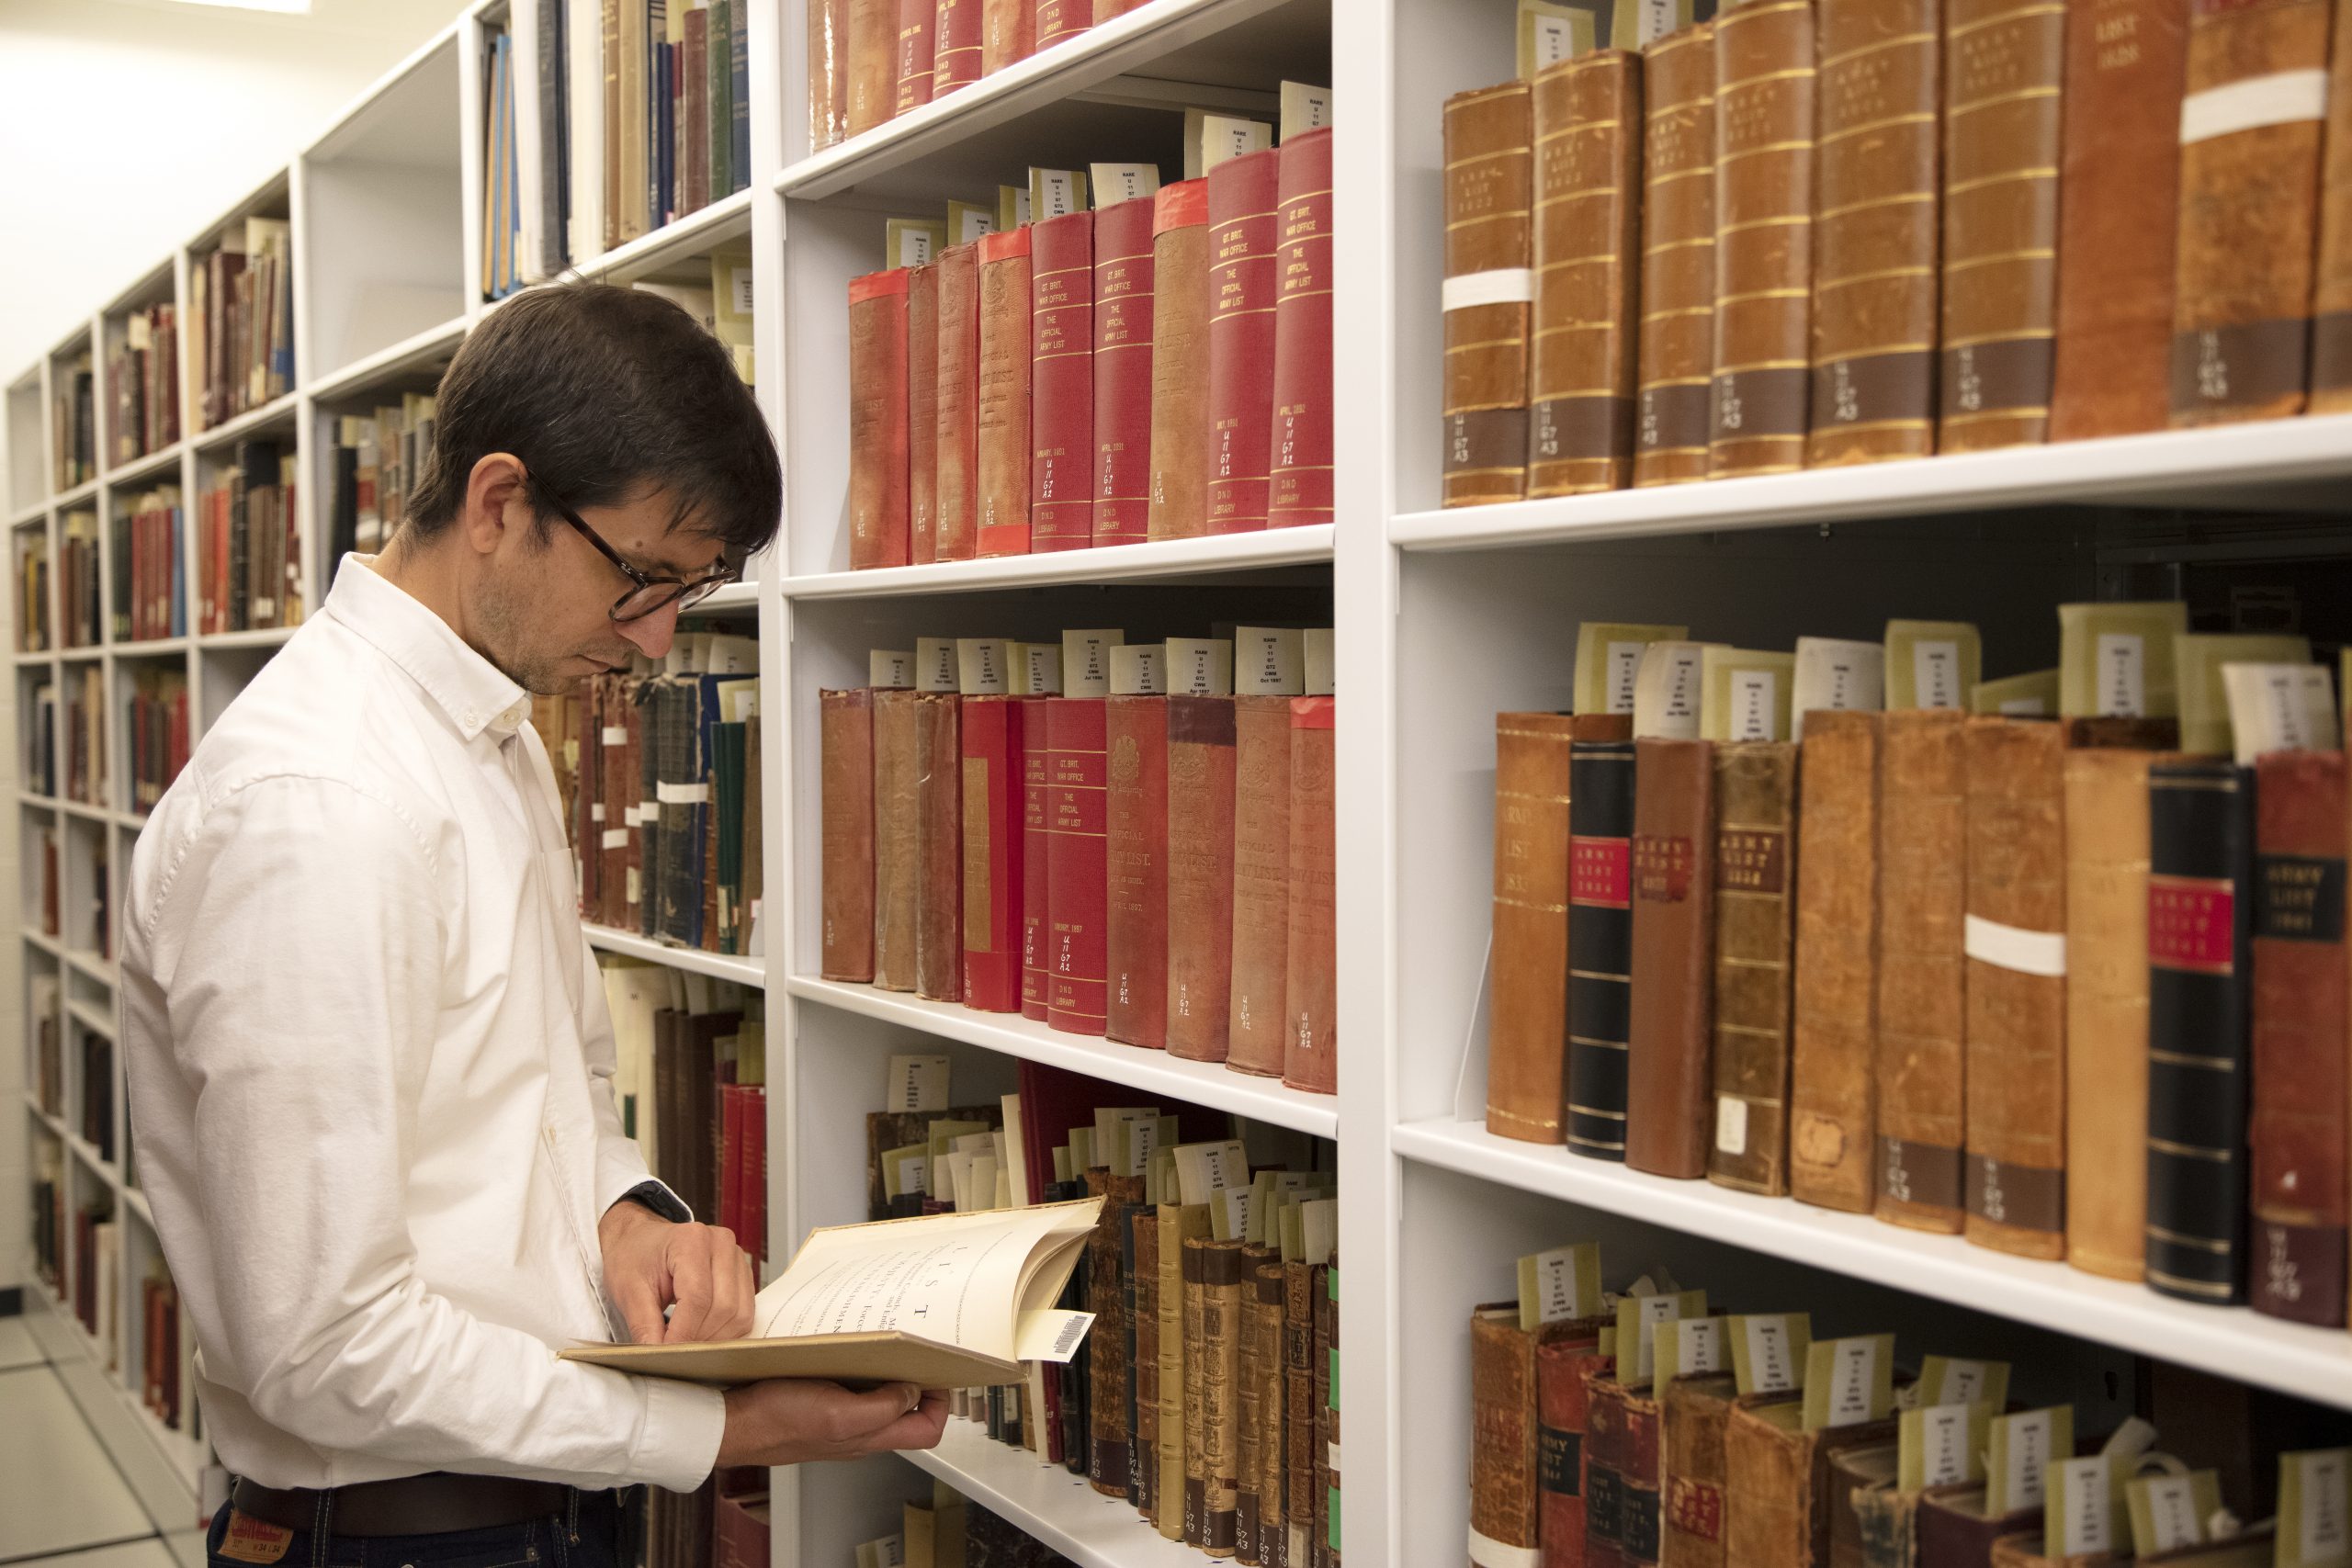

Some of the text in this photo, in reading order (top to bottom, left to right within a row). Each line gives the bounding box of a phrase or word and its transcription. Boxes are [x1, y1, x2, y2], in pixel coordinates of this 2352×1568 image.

[1044, 20, 1063, 35] LIBRARY
[941, 30, 950, 40] G7
[1299, 207, 1311, 218] BRIT.
[1286, 220, 1316, 236] WAR OFFICE
[1231, 229, 1243, 242] BRIT.
[1220, 243, 1248, 259] WAR OFFICE
[1293, 248, 1303, 258] THE
[1227, 269, 1237, 279] THE
[1287, 262, 1309, 276] OFFICIAL
[1104, 281, 1131, 295] WAR OFFICE
[1284, 276, 1312, 290] ARMY LIST
[1222, 282, 1241, 296] OFFICIAL
[1039, 293, 1068, 305] WAR OFFICE
[1220, 296, 1244, 310] ARMY LIST
[1111, 305, 1120, 314] THE
[1046, 316, 1057, 324] THE
[1106, 318, 1125, 328] OFFICIAL
[1041, 329, 1061, 338] OFFICIAL
[1104, 330, 1127, 342] ARMY LIST
[1040, 340, 1065, 351] ARMY LIST
[1286, 417, 1294, 427] U
[1283, 442, 1293, 454] G7
[1220, 454, 1230, 464] G7
[1282, 455, 1293, 466] A2
[1220, 465, 1230, 476] A2
[1103, 475, 1113, 484] G7
[1044, 480, 1053, 490] G7
[1103, 486, 1113, 495] A2
[1154, 488, 1162, 497] G7
[1277, 493, 1300, 504] LIBRARY
[1214, 503, 1236, 514] LIBRARY
[1038, 525, 1057, 533] LIBRARY
[1100, 521, 1119, 531] LIBRARY
[1068, 761, 1080, 769] BRIT.
[1057, 773, 1084, 782] WAR OFFICE
[1065, 793, 1073, 802] THE
[1059, 805, 1079, 814] OFFICIAL
[1058, 818, 1069, 827] ARMY
[1720, 836, 1772, 852] ARMY
[1061, 953, 1071, 962] G7
[1060, 963, 1070, 971] A2
[1057, 998, 1076, 1007] LIBRARY
[1120, 996, 1128, 1004] A2
[1179, 1008, 1190, 1016] A2
[1241, 1012, 1250, 1021] G7
[1301, 1030, 1311, 1039] G7
[1301, 1039, 1311, 1048] A2
[1186, 1521, 1194, 1532] A3
[1203, 1526, 1212, 1536] G7
[1237, 1528, 1248, 1539] G7
[1203, 1536, 1211, 1546] A3
[1237, 1539, 1248, 1550] A3
[1260, 1543, 1270, 1554] G7
[1260, 1553, 1269, 1565] A3
